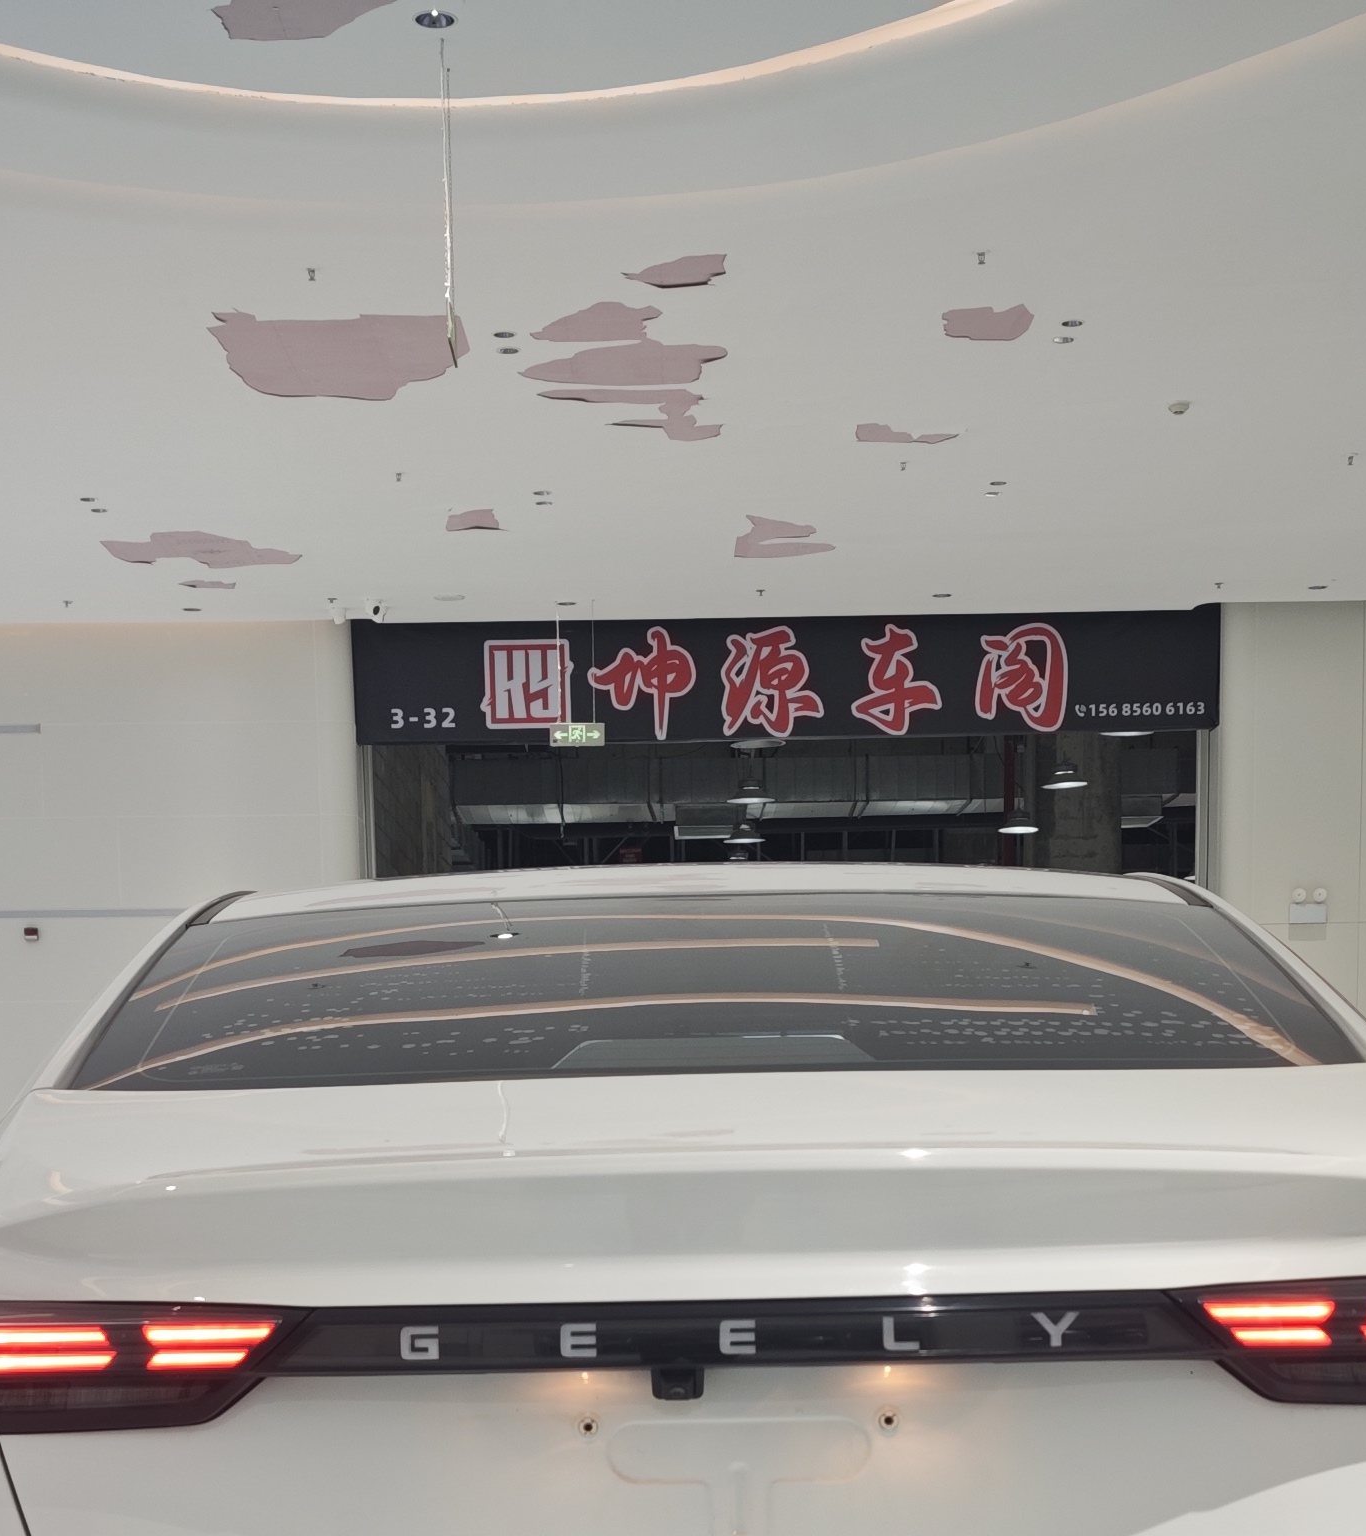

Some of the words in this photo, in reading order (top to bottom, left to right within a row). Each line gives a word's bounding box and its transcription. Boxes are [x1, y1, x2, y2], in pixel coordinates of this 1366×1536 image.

[390, 706, 456, 729] 3-32
[1088, 703, 1118, 717] 156
[1121, 702, 1162, 716] 8560
[1165, 701, 1205, 715] 6163
[400, 1311, 1080, 1361] GEELY
